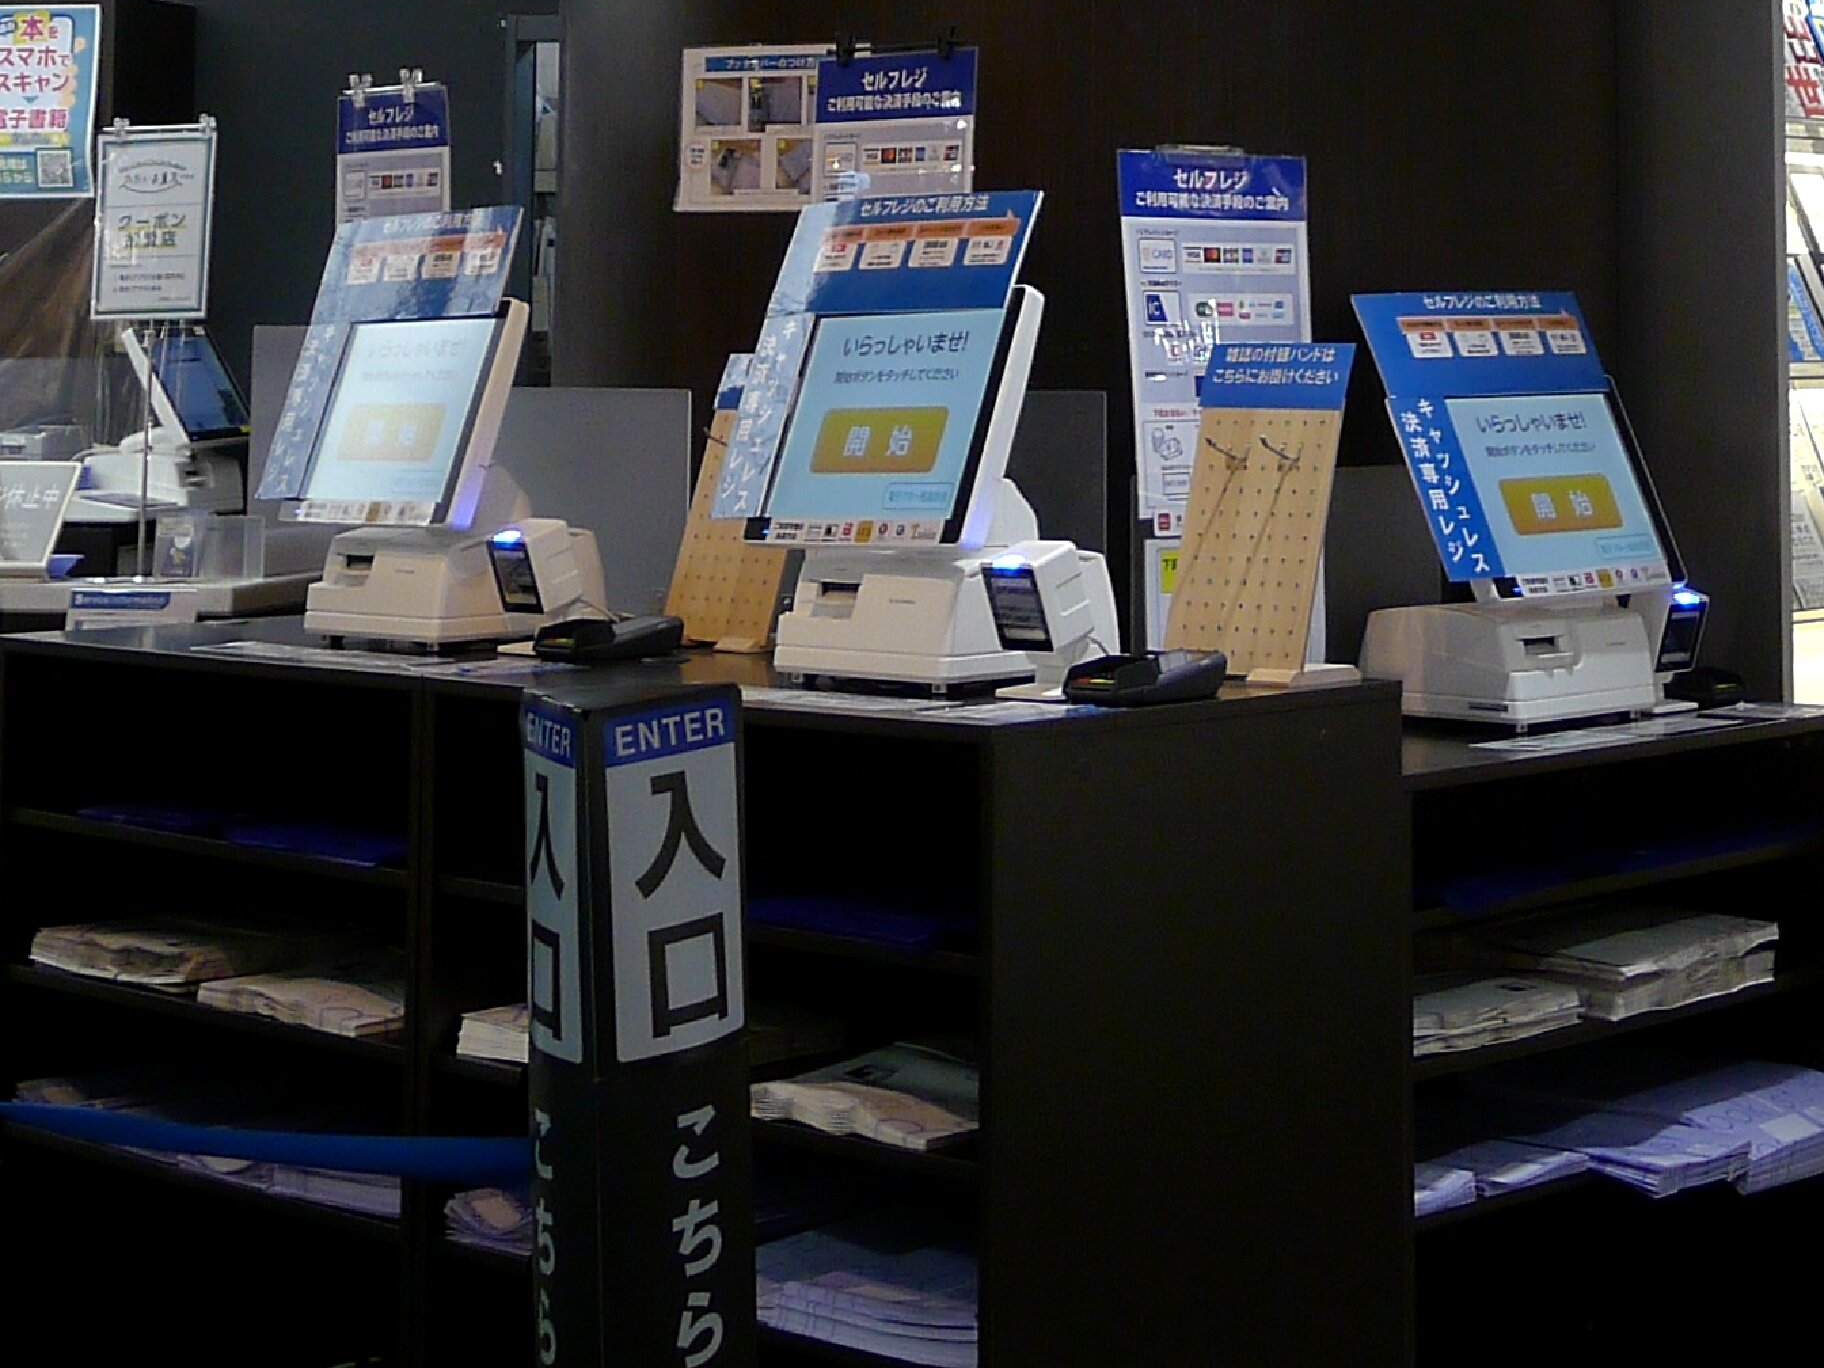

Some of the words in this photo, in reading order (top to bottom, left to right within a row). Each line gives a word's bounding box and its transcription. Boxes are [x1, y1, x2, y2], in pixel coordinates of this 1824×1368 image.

[862, 67, 928, 92] セルフレジ
[1173, 168, 1248, 190] セルフレジ
[526, 710, 571, 759] ENTER
[615, 707, 726, 756] ENTER
[529, 771, 564, 1041] 入口
[635, 770, 728, 1039] 入口
[670, 1104, 724, 1368] こちら
